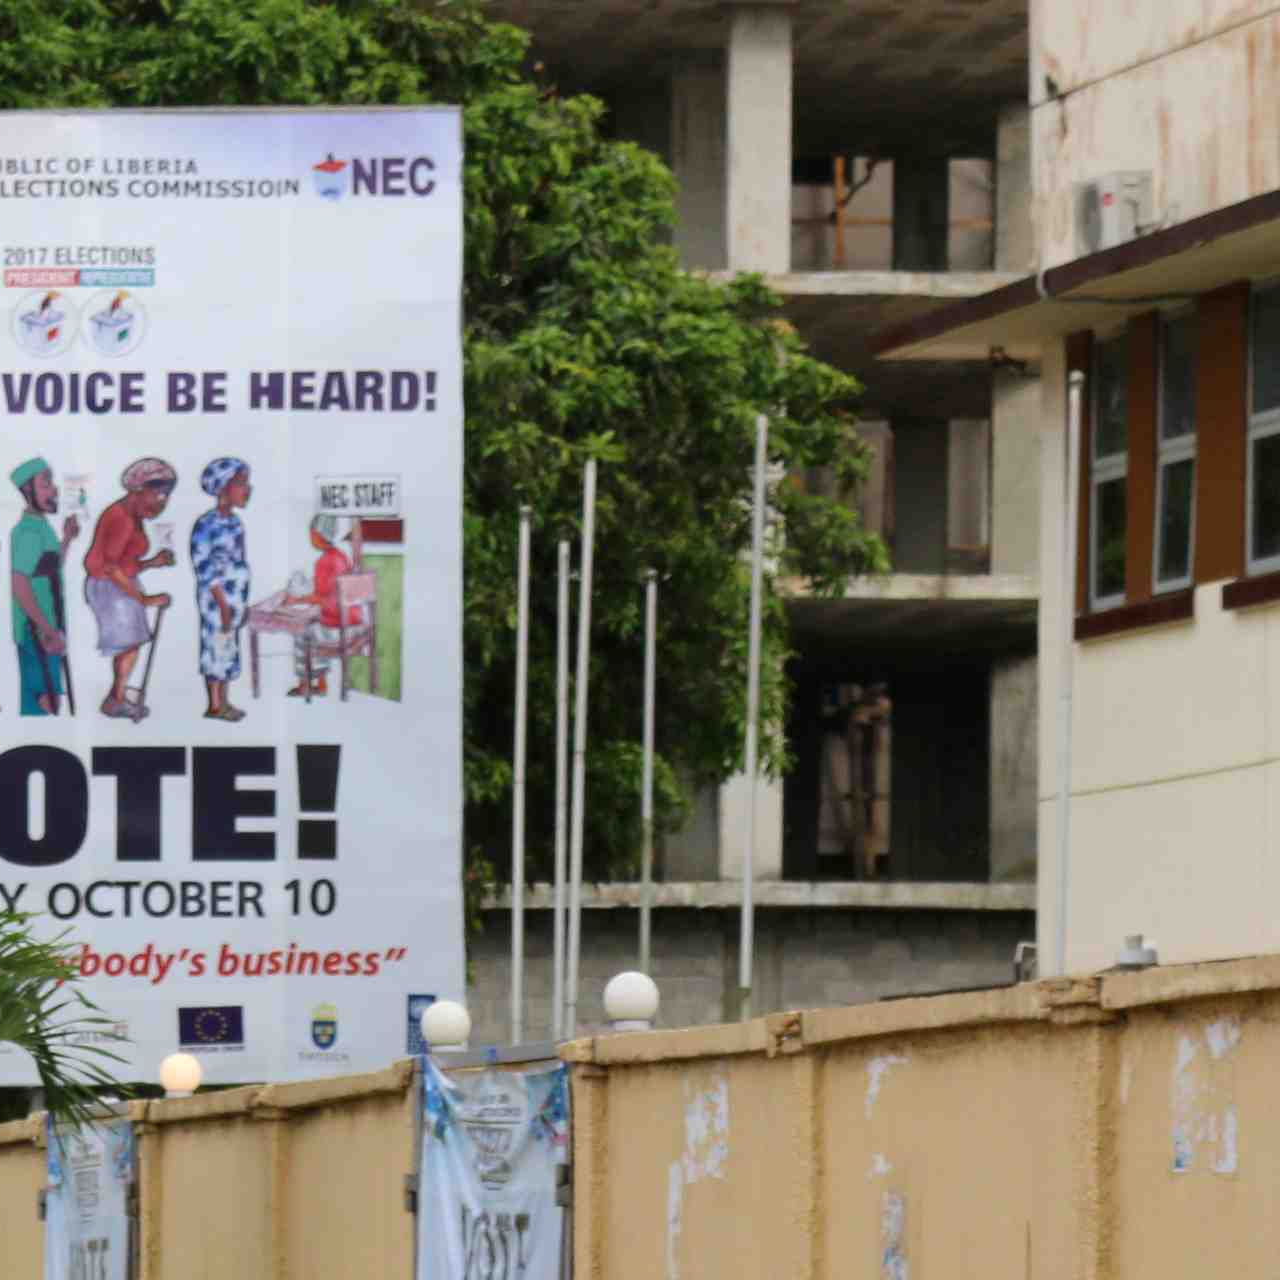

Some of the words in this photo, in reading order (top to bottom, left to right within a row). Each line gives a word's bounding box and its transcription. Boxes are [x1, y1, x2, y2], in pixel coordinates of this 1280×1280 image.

[65, 158, 96, 175] OF
[102, 158, 199, 175] LIBERIA
[351, 156, 436, 196] NEC
[3, 247, 48, 265] 2017
[54, 246, 156, 265] ELECTIONS
[2, 371, 147, 415] VOICE
[166, 371, 229, 414] BE
[248, 369, 439, 413] HEARD!
[321, 485, 348, 508] NEC
[353, 482, 396, 507] STAFF
[47, 879, 264, 921] OCTOBER
[284, 878, 337, 917] 10
